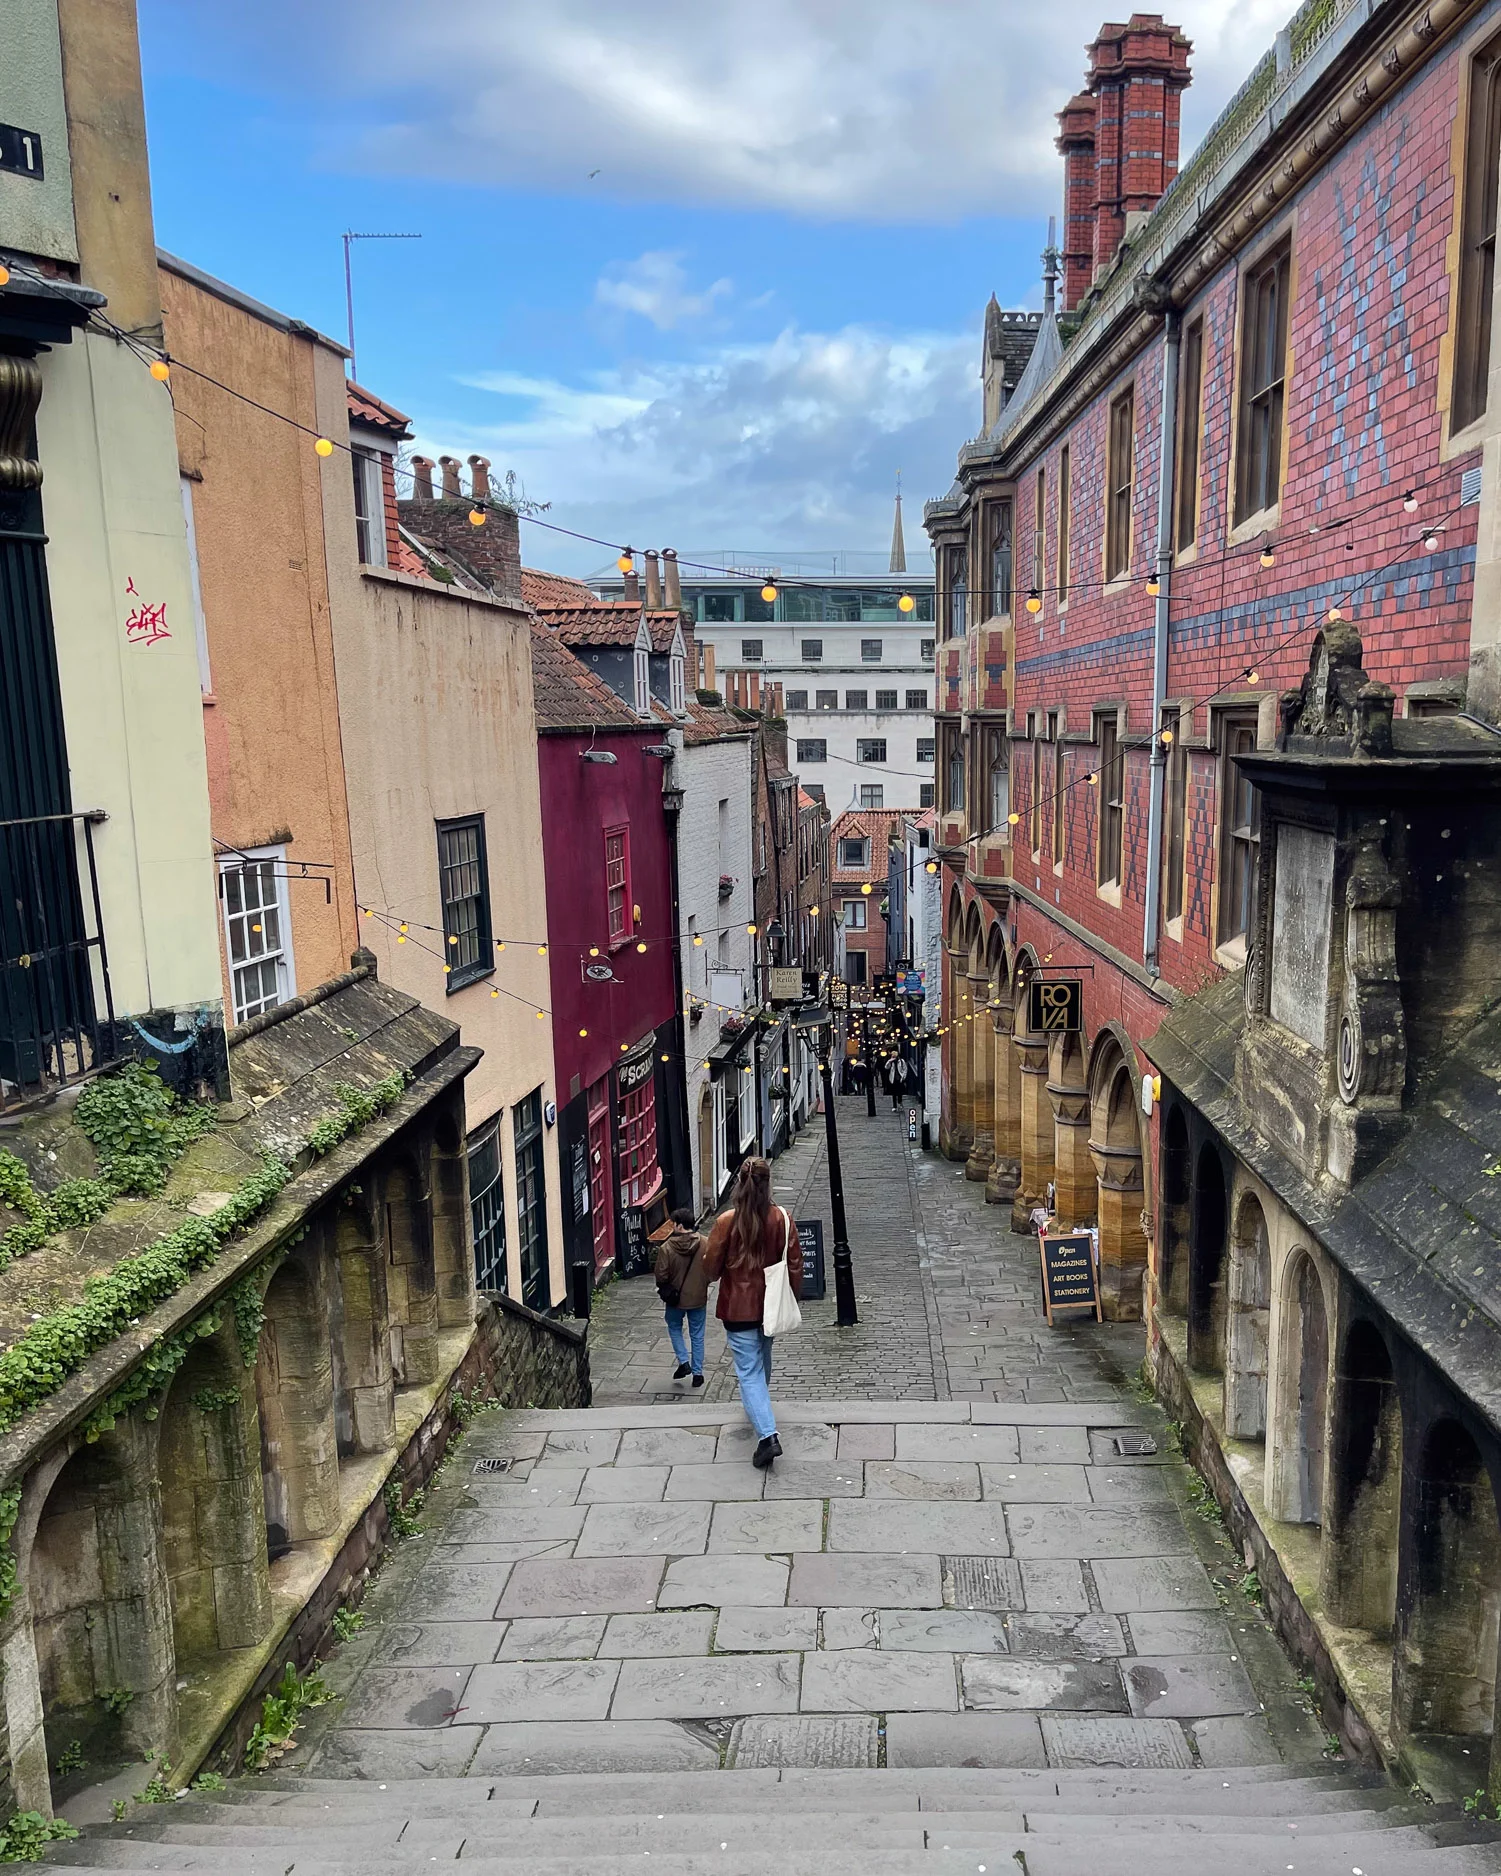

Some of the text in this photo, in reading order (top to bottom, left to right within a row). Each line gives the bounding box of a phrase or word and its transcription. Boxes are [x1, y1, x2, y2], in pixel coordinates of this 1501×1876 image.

[776, 976, 797, 985] Reilly
[1058, 1246, 1076, 1257] Open
[1050, 1259, 1087, 1268] MAGAZINES
[1053, 1273, 1088, 1282] ART BOOKS
[1053, 1287, 1090, 1297] STATIONERY
